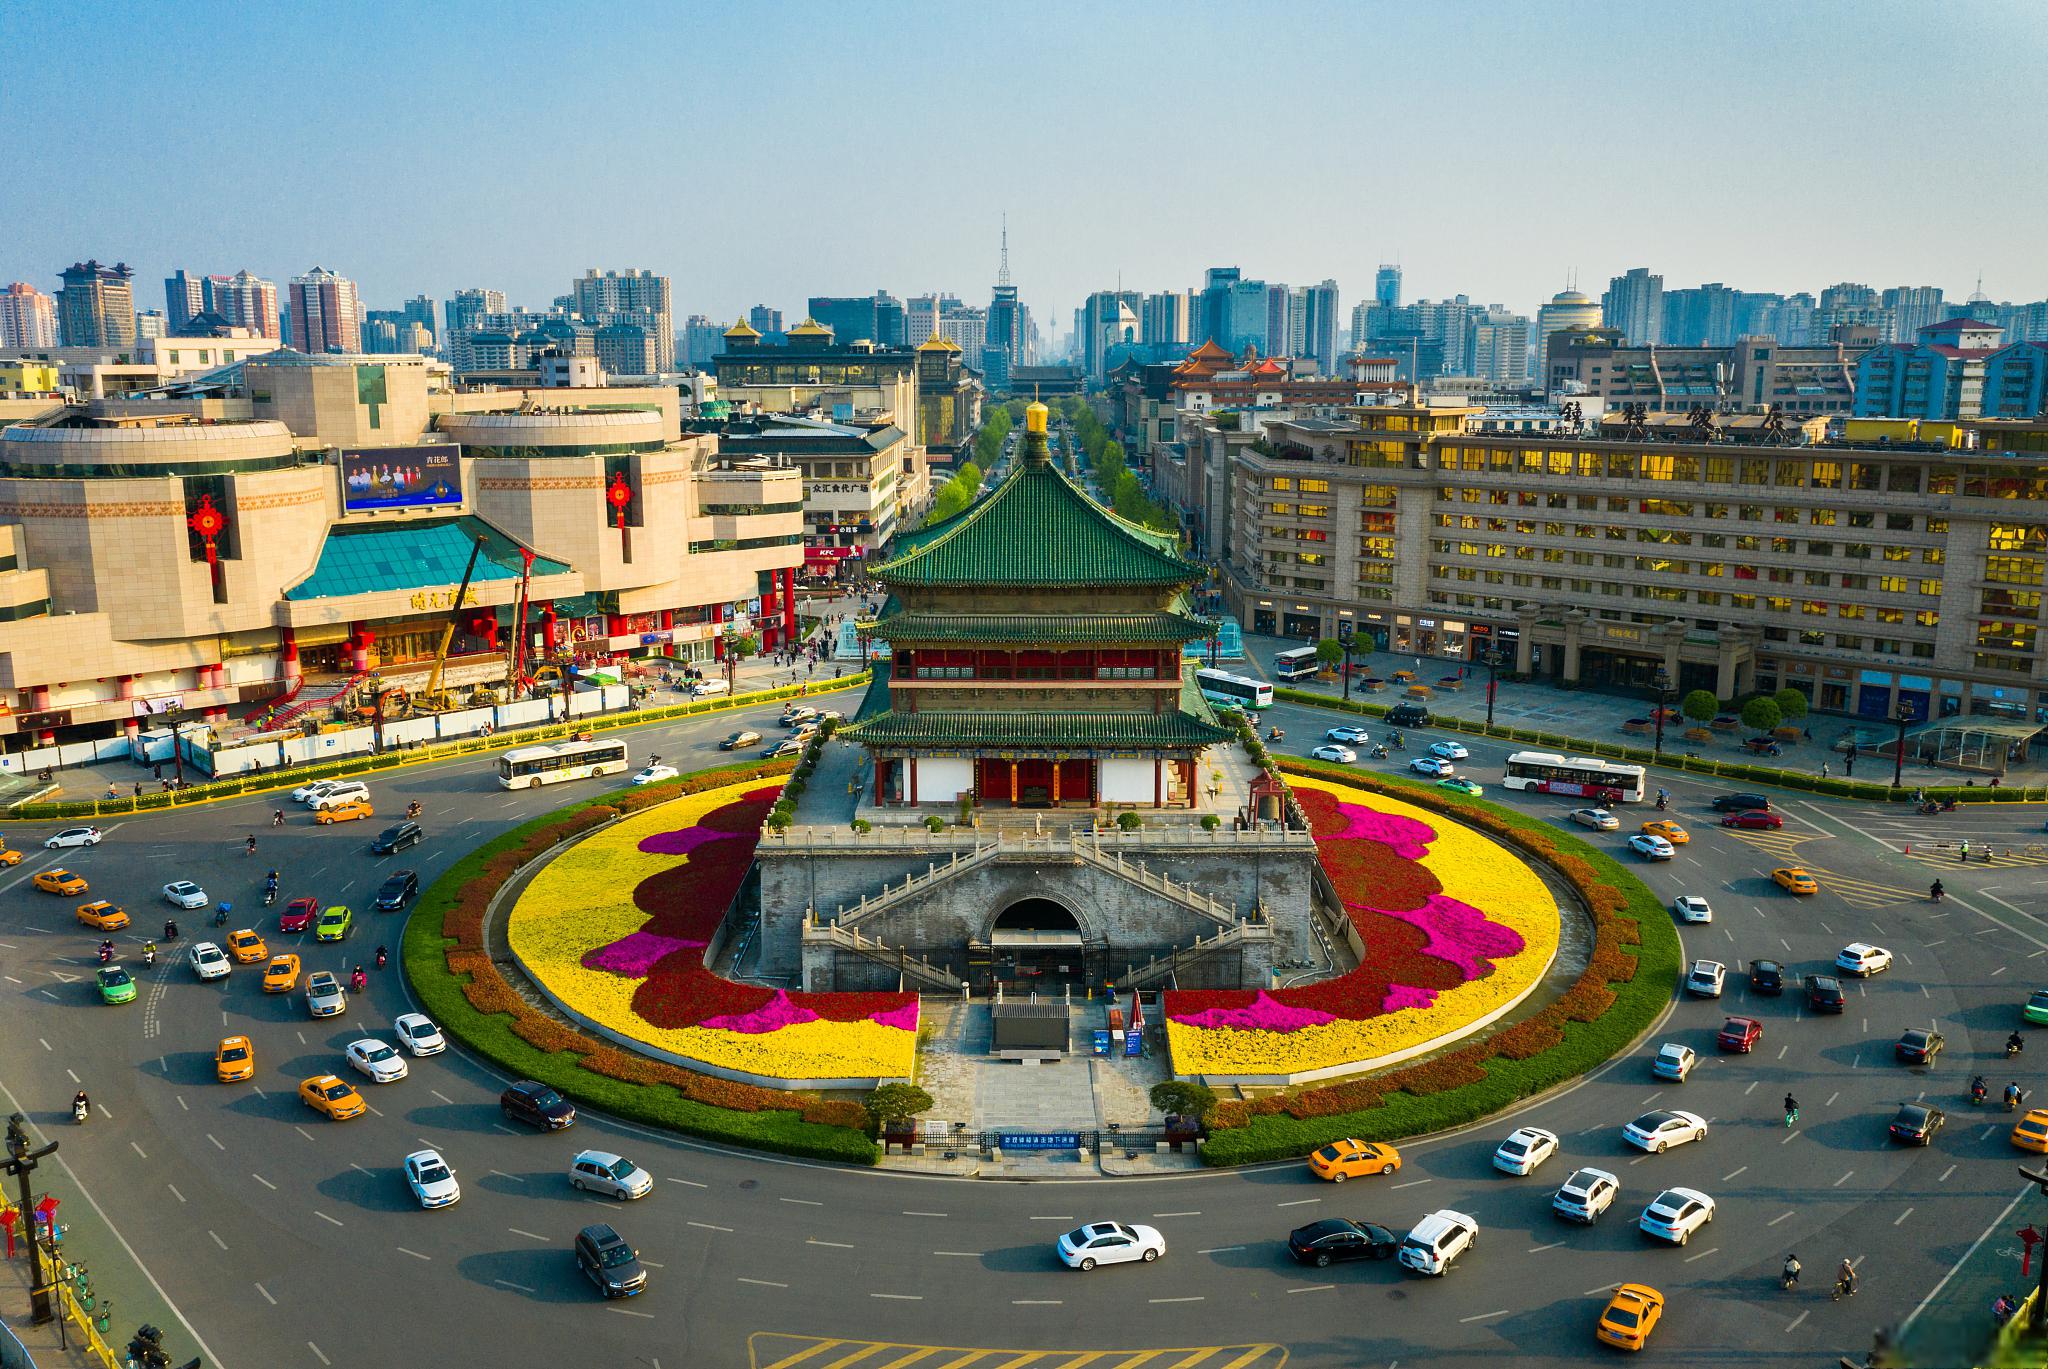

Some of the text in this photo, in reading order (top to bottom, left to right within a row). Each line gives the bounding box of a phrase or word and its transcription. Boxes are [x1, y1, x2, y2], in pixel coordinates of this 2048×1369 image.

[813, 484, 869, 493] 众汇食代广场
